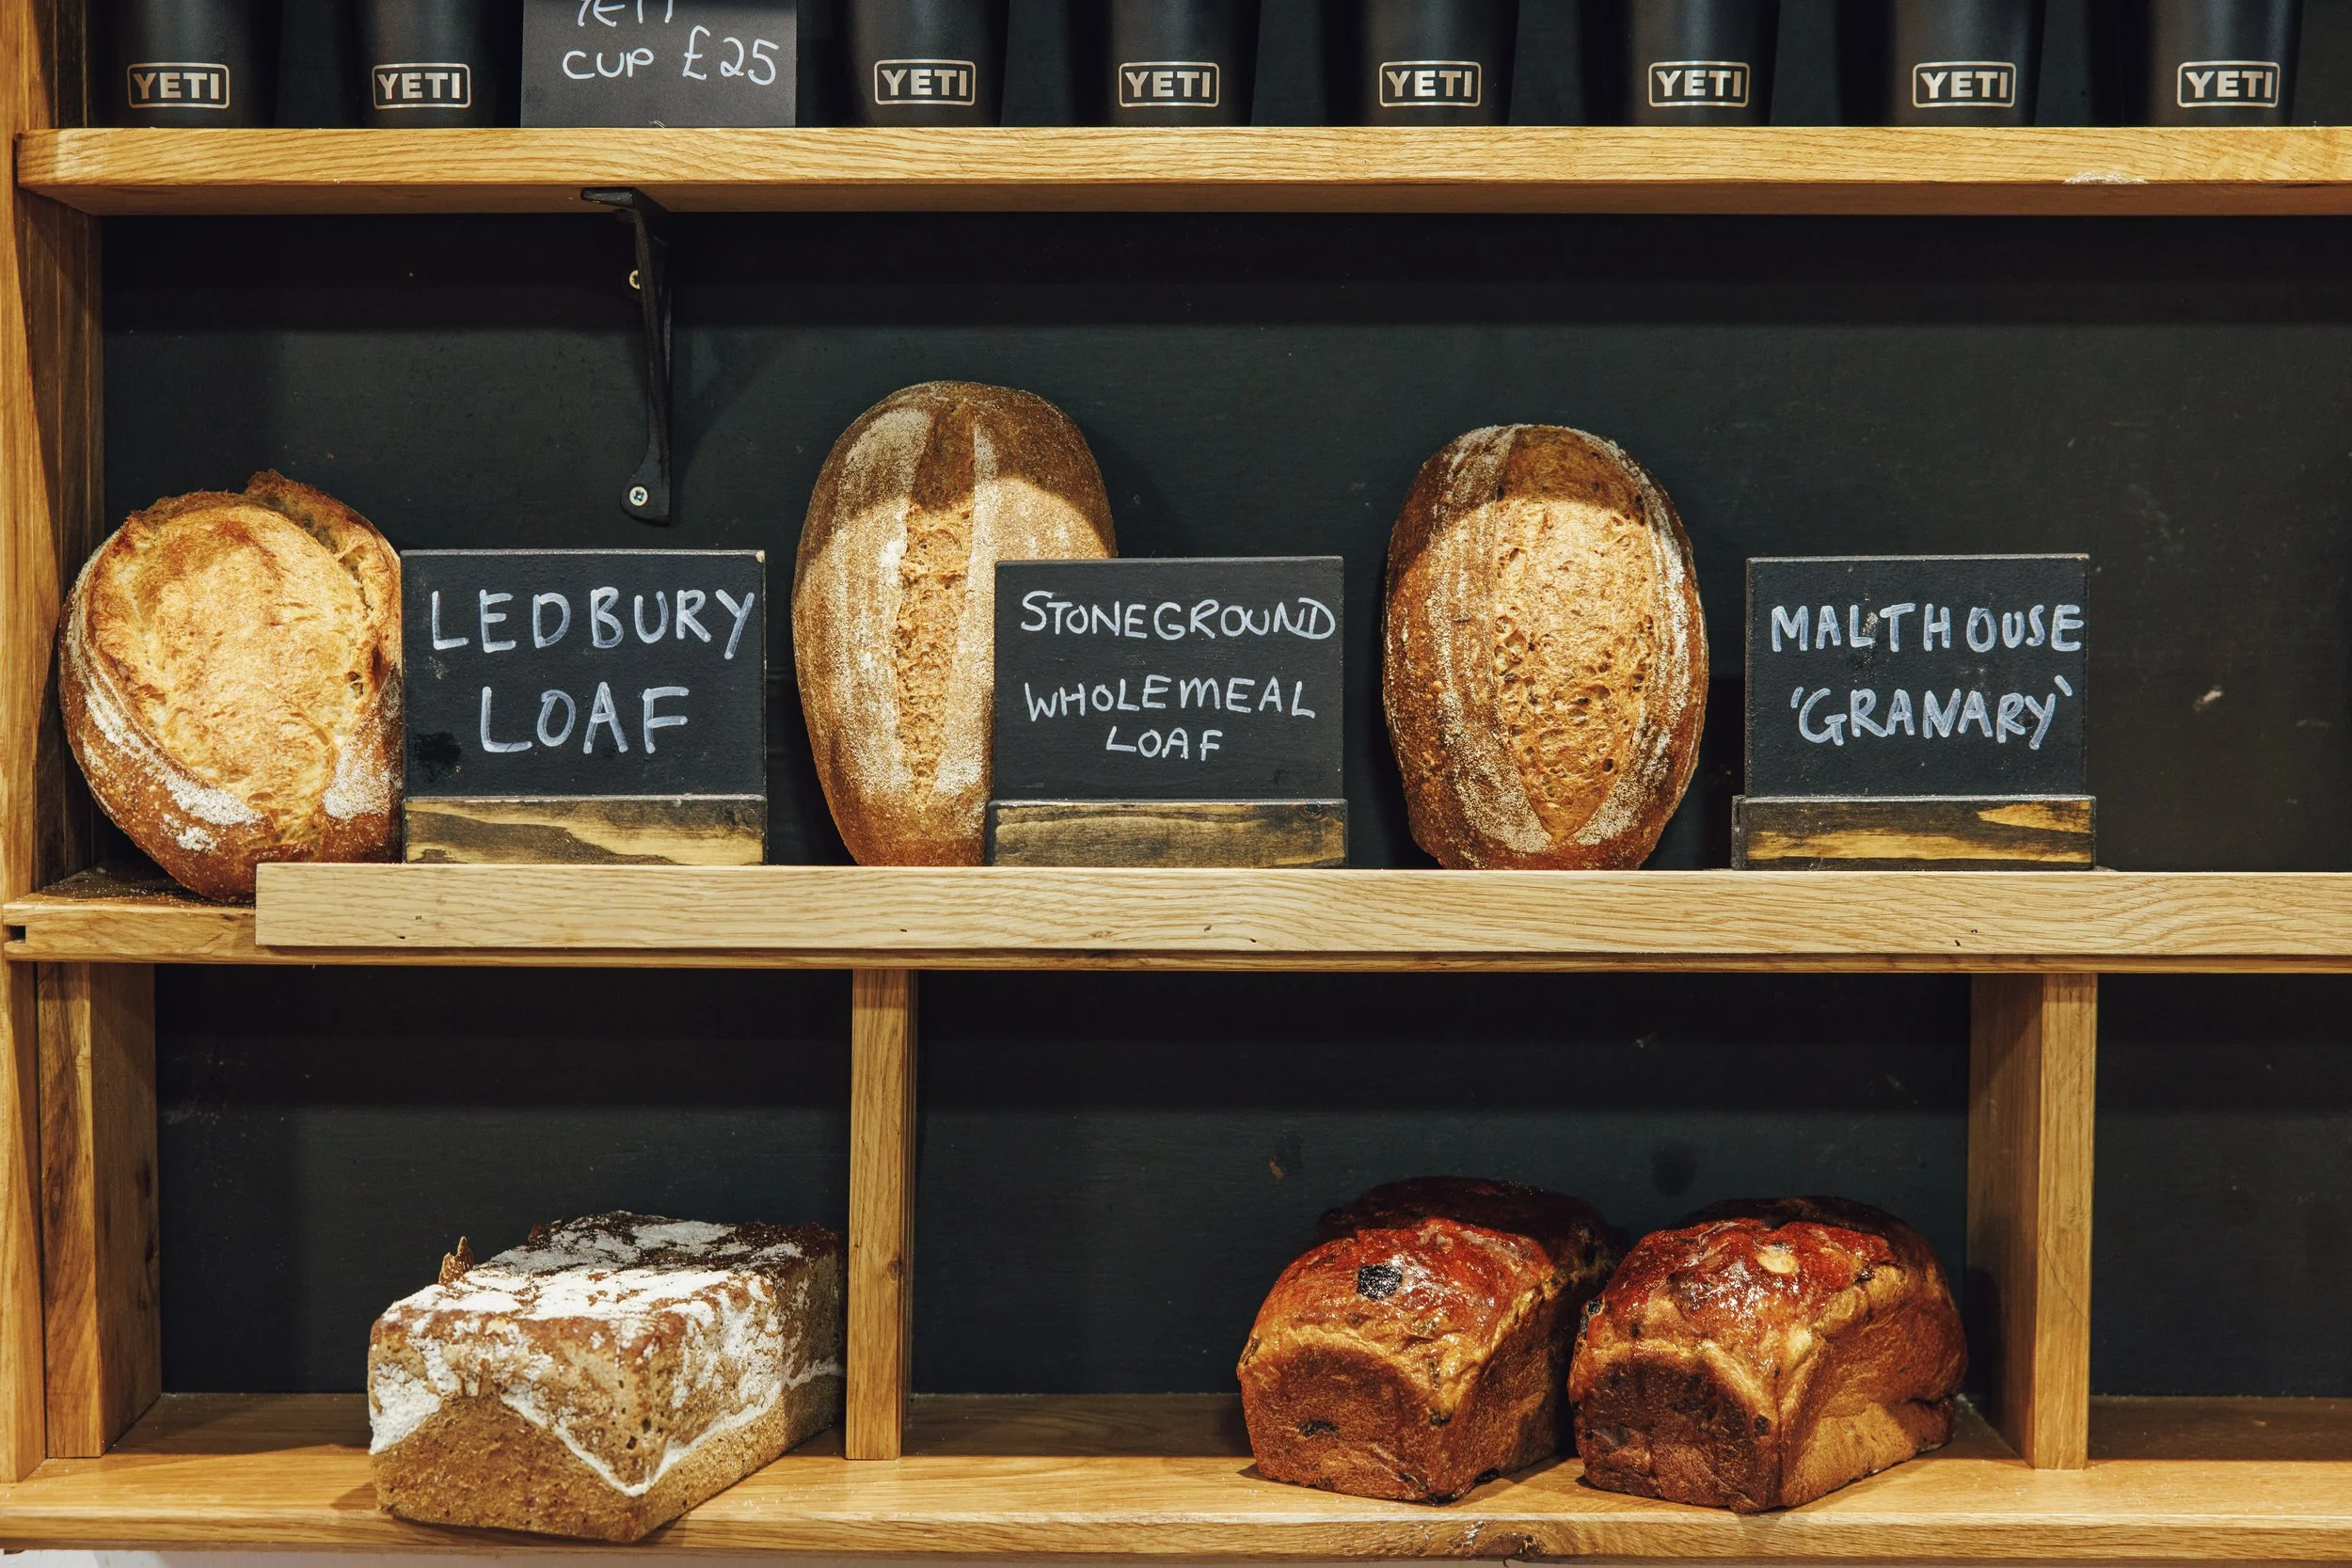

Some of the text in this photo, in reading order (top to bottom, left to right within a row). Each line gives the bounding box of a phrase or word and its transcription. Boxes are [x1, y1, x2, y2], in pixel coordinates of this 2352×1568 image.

[563, 24, 780, 86] CUP £25
[133, 71, 220, 100] YETI
[376, 71, 461, 101] YETI
[880, 68, 968, 97] YETI
[1124, 71, 1211, 98] YETI
[1385, 70, 1472, 98] YETI
[1655, 69, 1742, 98] YETI
[1919, 71, 2009, 100] YETI
[2185, 70, 2273, 99] YETI
[431, 586, 755, 660] LEDBURY
[1020, 590, 1336, 641] STONEGROUND
[1771, 602, 2085, 653] MALTHOUSE
[1024, 673, 1316, 722] WHOLEMEAL
[480, 681, 690, 754] LOAF
[1105, 725, 1223, 762] LOAF
